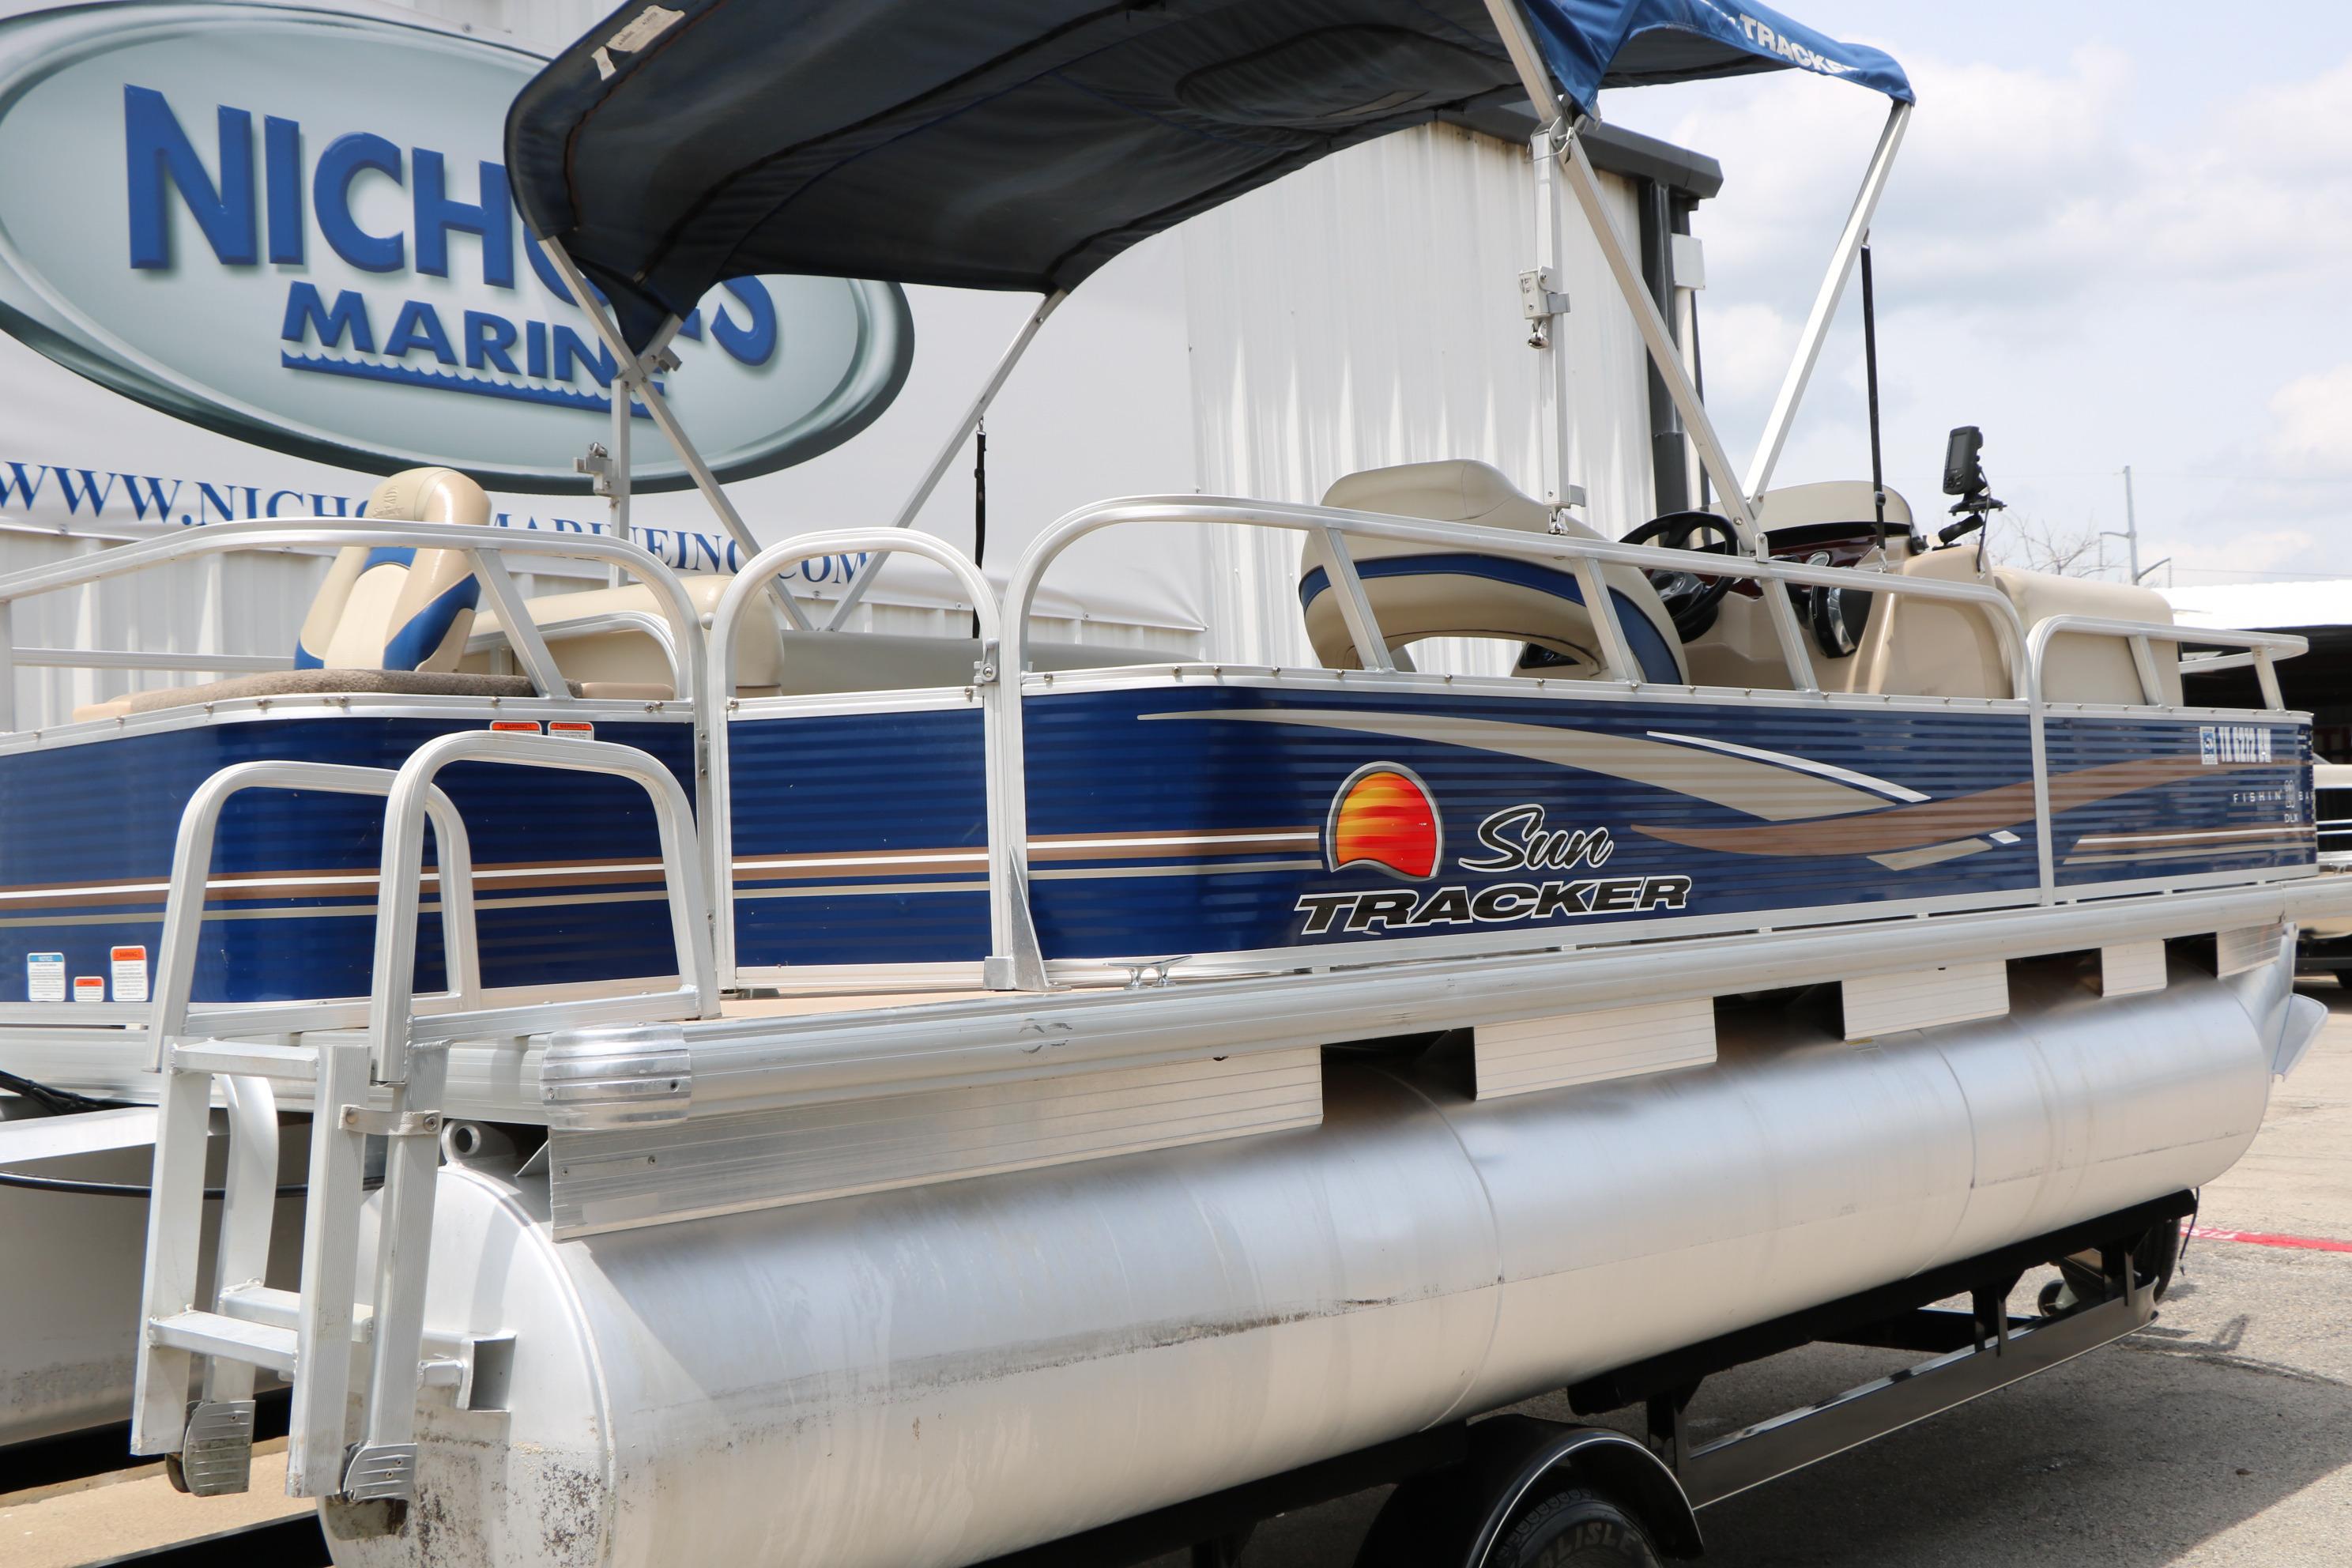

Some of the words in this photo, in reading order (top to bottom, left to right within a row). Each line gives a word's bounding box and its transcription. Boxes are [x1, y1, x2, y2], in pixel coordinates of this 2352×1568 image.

[122, 82, 778, 367] NICHS
[281, 279, 665, 396] MARIN
[1458, 804, 1614, 873] Sun
[1294, 875, 1692, 935] TRACKER
